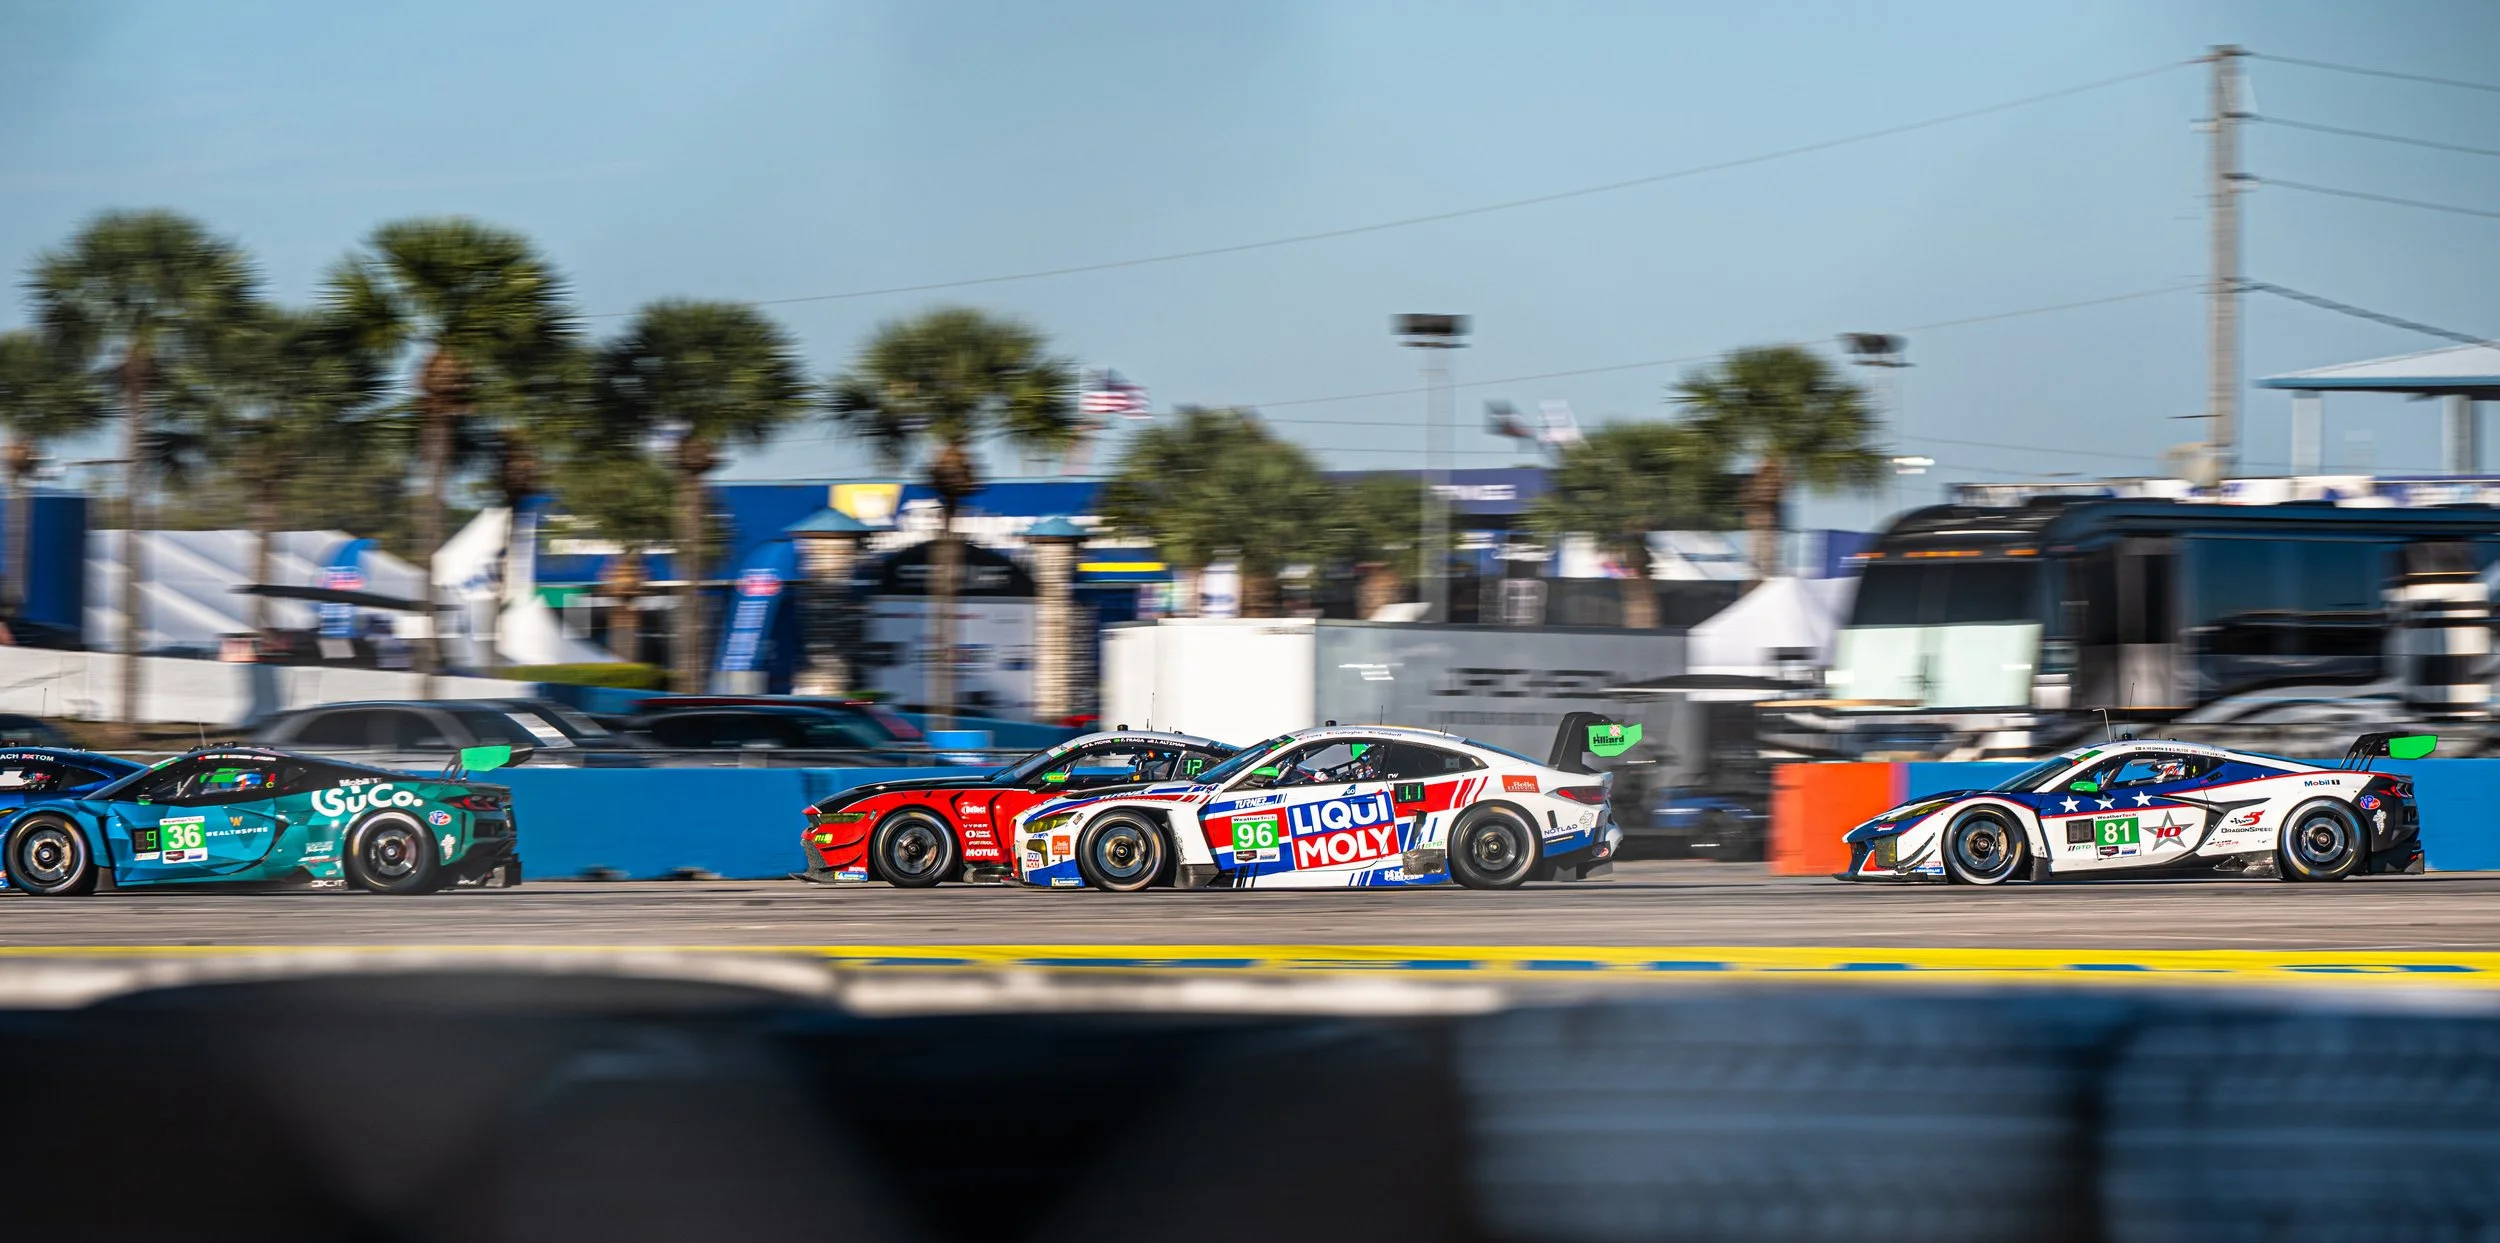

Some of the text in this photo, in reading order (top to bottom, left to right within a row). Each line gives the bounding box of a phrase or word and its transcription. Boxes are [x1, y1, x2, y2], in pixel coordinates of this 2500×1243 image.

[1159, 740, 1185, 748] ALTZMAN
[1593, 733, 1624, 744] Hilliard
[36, 754, 54, 762] TOM
[2304, 779, 2330, 787] Mobil
[1235, 796, 1267, 809] TURNER
[1292, 791, 1389, 835] LIQUI
[2097, 812, 2137, 820] WeatherTech
[1237, 822, 1273, 848] 96
[1543, 823, 1578, 836] NOTLAD
[2104, 821, 2131, 844] 81
[2156, 826, 2182, 838] 10
[147, 830, 156, 850] 9
[167, 824, 201, 849] 36
[1298, 825, 1394, 867] MOLY
[965, 849, 998, 857] MOTUL
